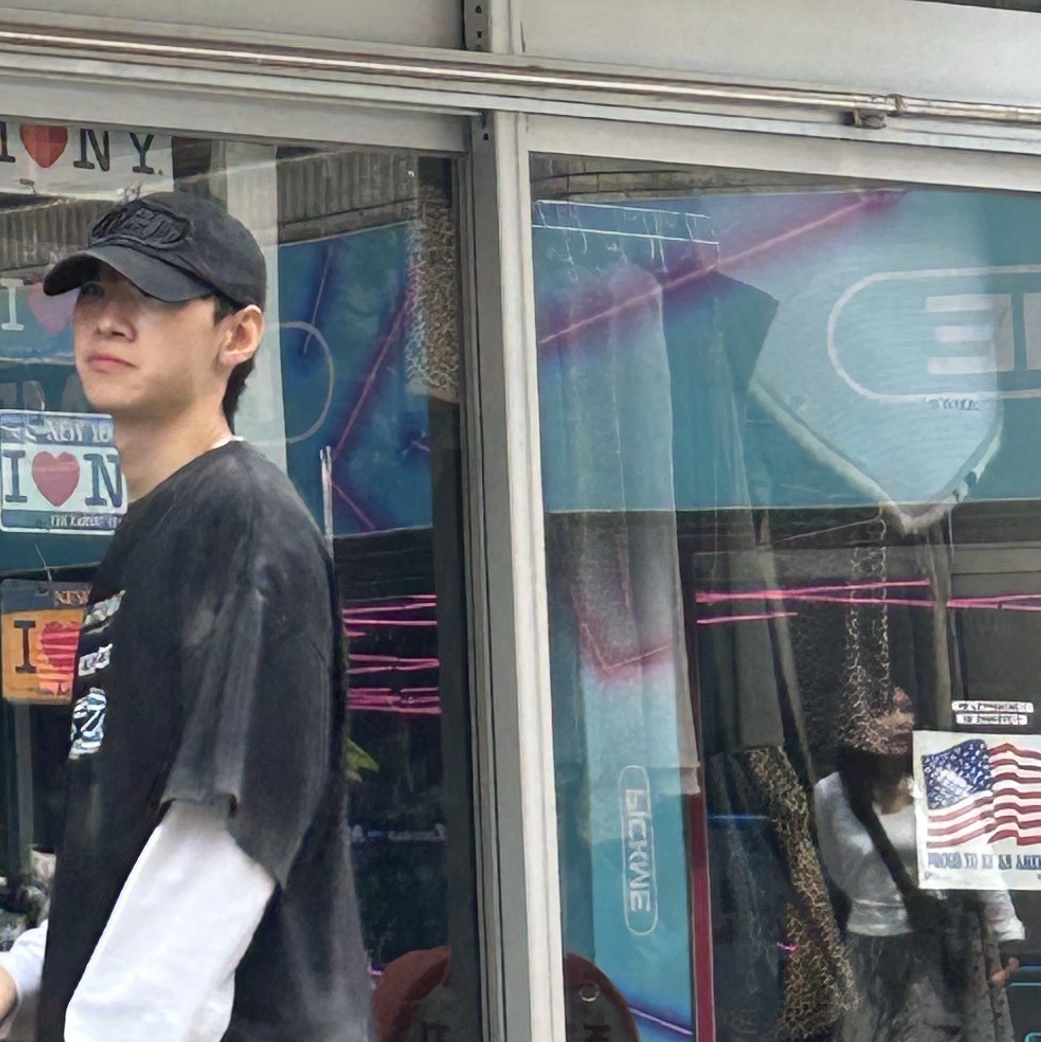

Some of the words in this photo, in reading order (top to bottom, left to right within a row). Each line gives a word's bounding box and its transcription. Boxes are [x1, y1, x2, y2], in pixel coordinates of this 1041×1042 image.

[1, 278, 25, 331] I
[3, 449, 28, 503] I
[83, 453, 123, 508] N
[13, 620, 37, 674] I
